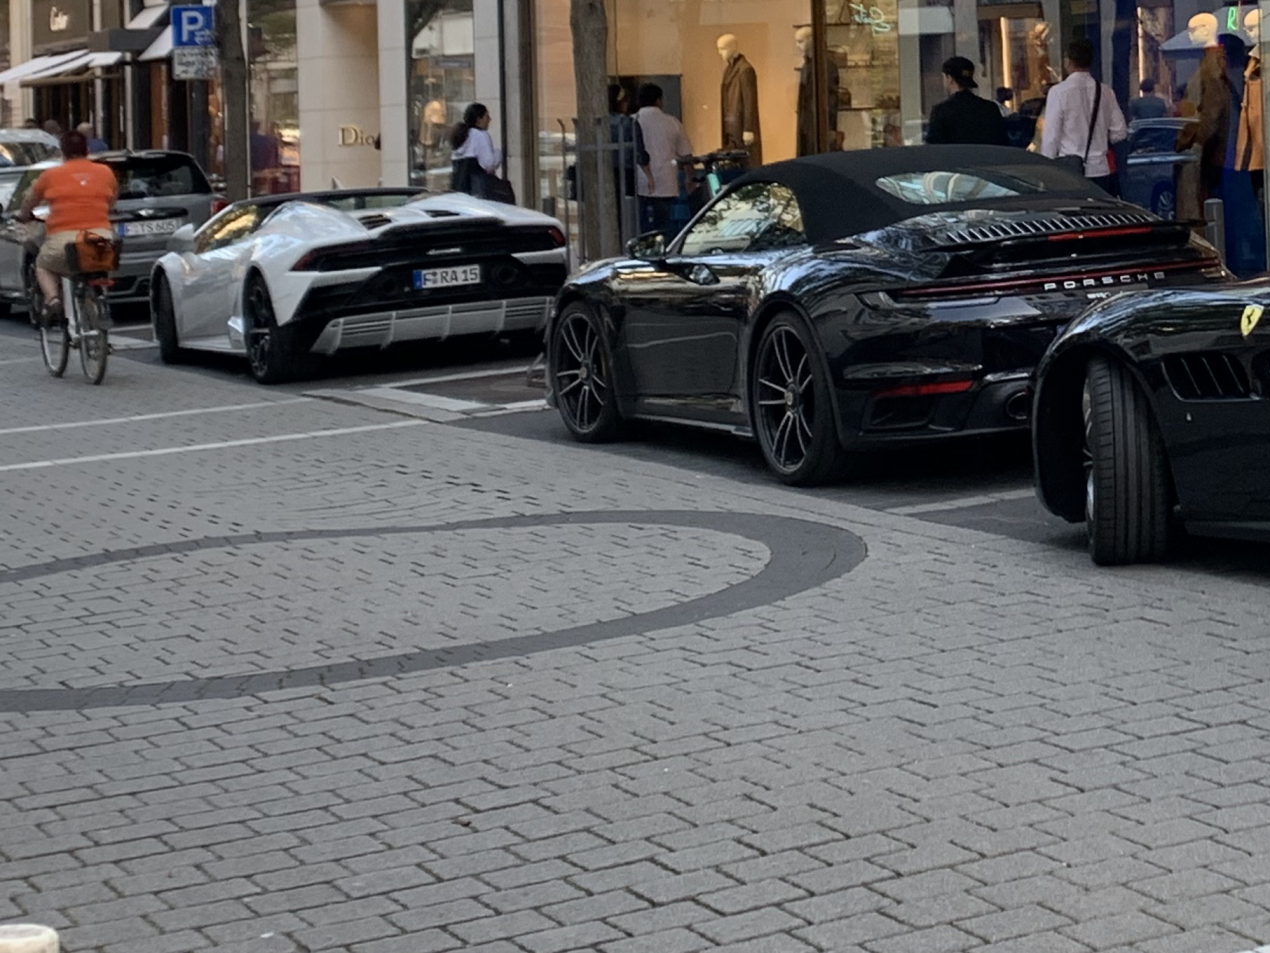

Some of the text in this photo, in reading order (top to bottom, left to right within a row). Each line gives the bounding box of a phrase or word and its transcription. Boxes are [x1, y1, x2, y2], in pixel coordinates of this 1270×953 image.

[180, 10, 204, 43] P
[338, 125, 375, 147] Dio
[440, 269, 459, 284] RA
[461, 267, 479, 282] 15
[1043, 271, 1166, 291] PORSCHE
